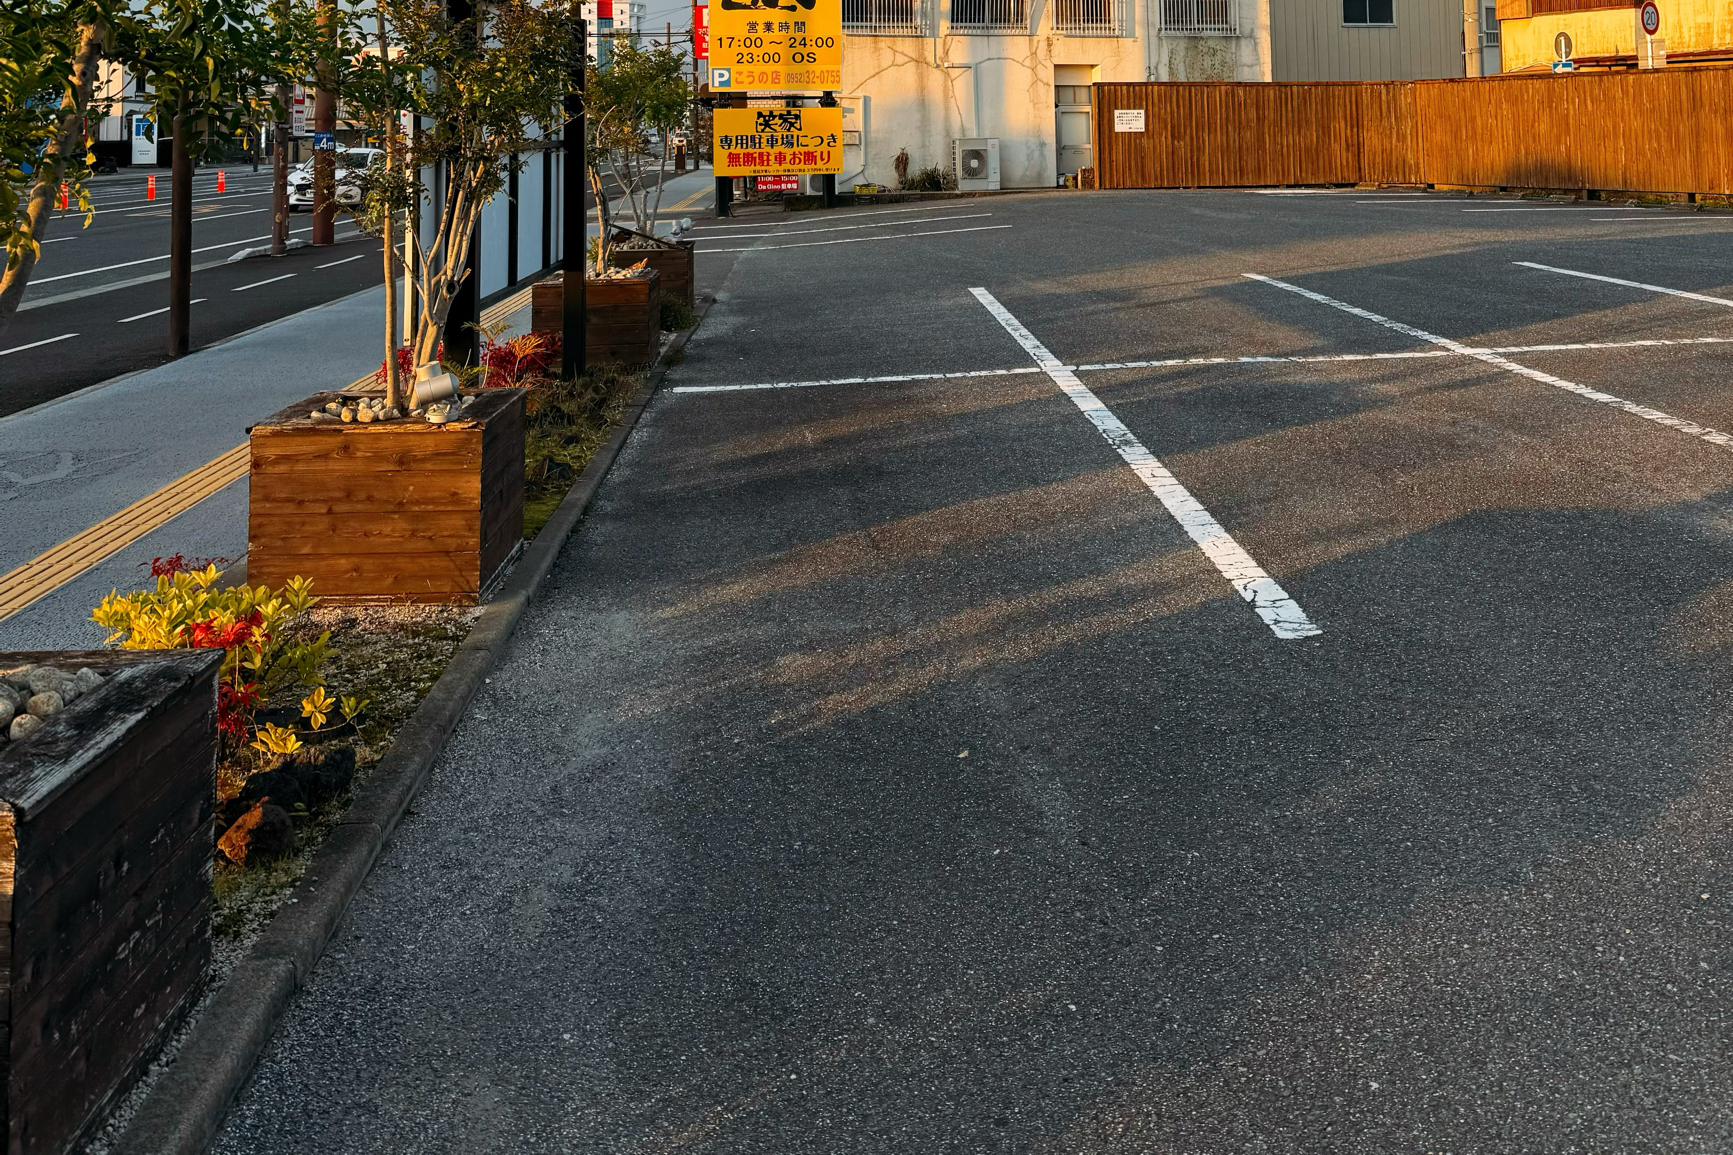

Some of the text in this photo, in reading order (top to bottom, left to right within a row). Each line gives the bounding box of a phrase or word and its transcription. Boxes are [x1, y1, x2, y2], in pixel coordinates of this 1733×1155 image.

[1645, 11, 1656, 25] 20
[747, 21, 806, 34] 営業時間
[717, 37, 763, 48] 17:00
[788, 37, 834, 48] 24:00
[736, 52, 817, 64] 23:00 OS
[735, 71, 781, 85] こうの店
[755, 110, 802, 133] 笑家
[719, 133, 838, 150] 専用駐車場につき
[727, 150, 831, 167] 無断駐車お断り
